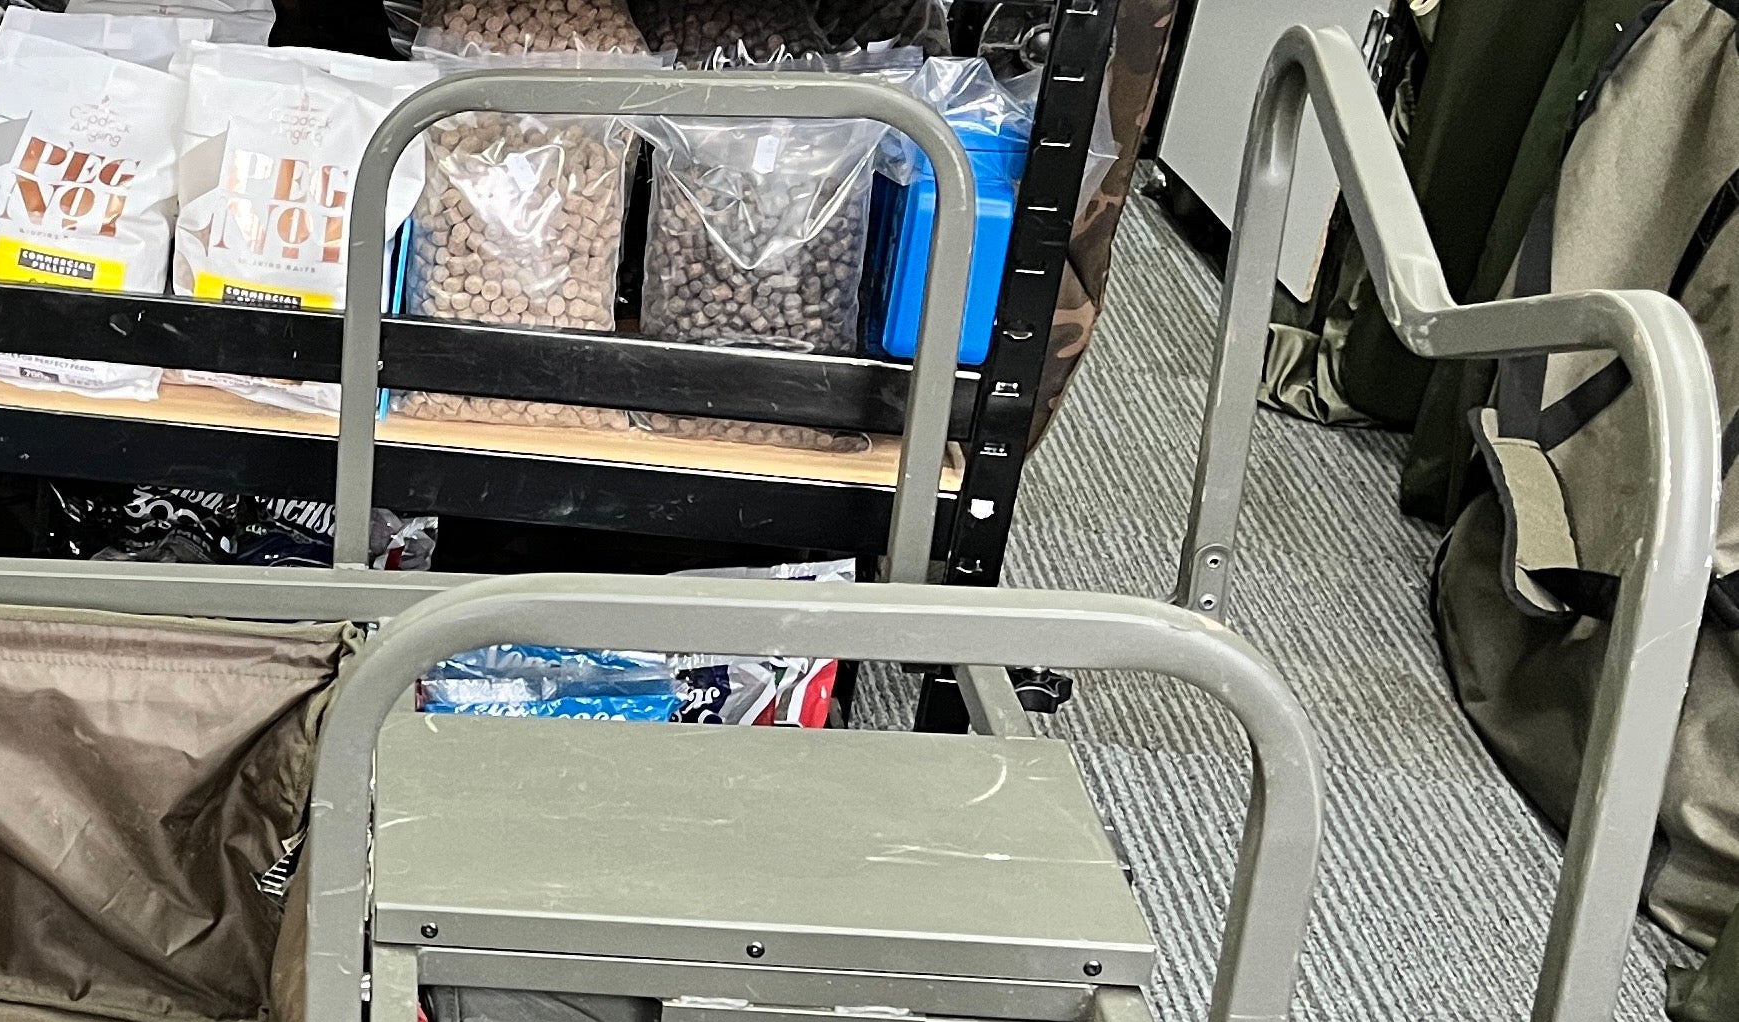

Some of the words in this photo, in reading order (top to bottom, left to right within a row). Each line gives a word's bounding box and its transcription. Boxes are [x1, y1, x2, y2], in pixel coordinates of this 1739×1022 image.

[19, 136, 141, 188] PEG
[228, 149, 349, 210] PEG
[22, 250, 93, 272] COMMERCIAL
[32, 260, 79, 277] PELLETS
[225, 286, 298, 305] COMMERCIAL
